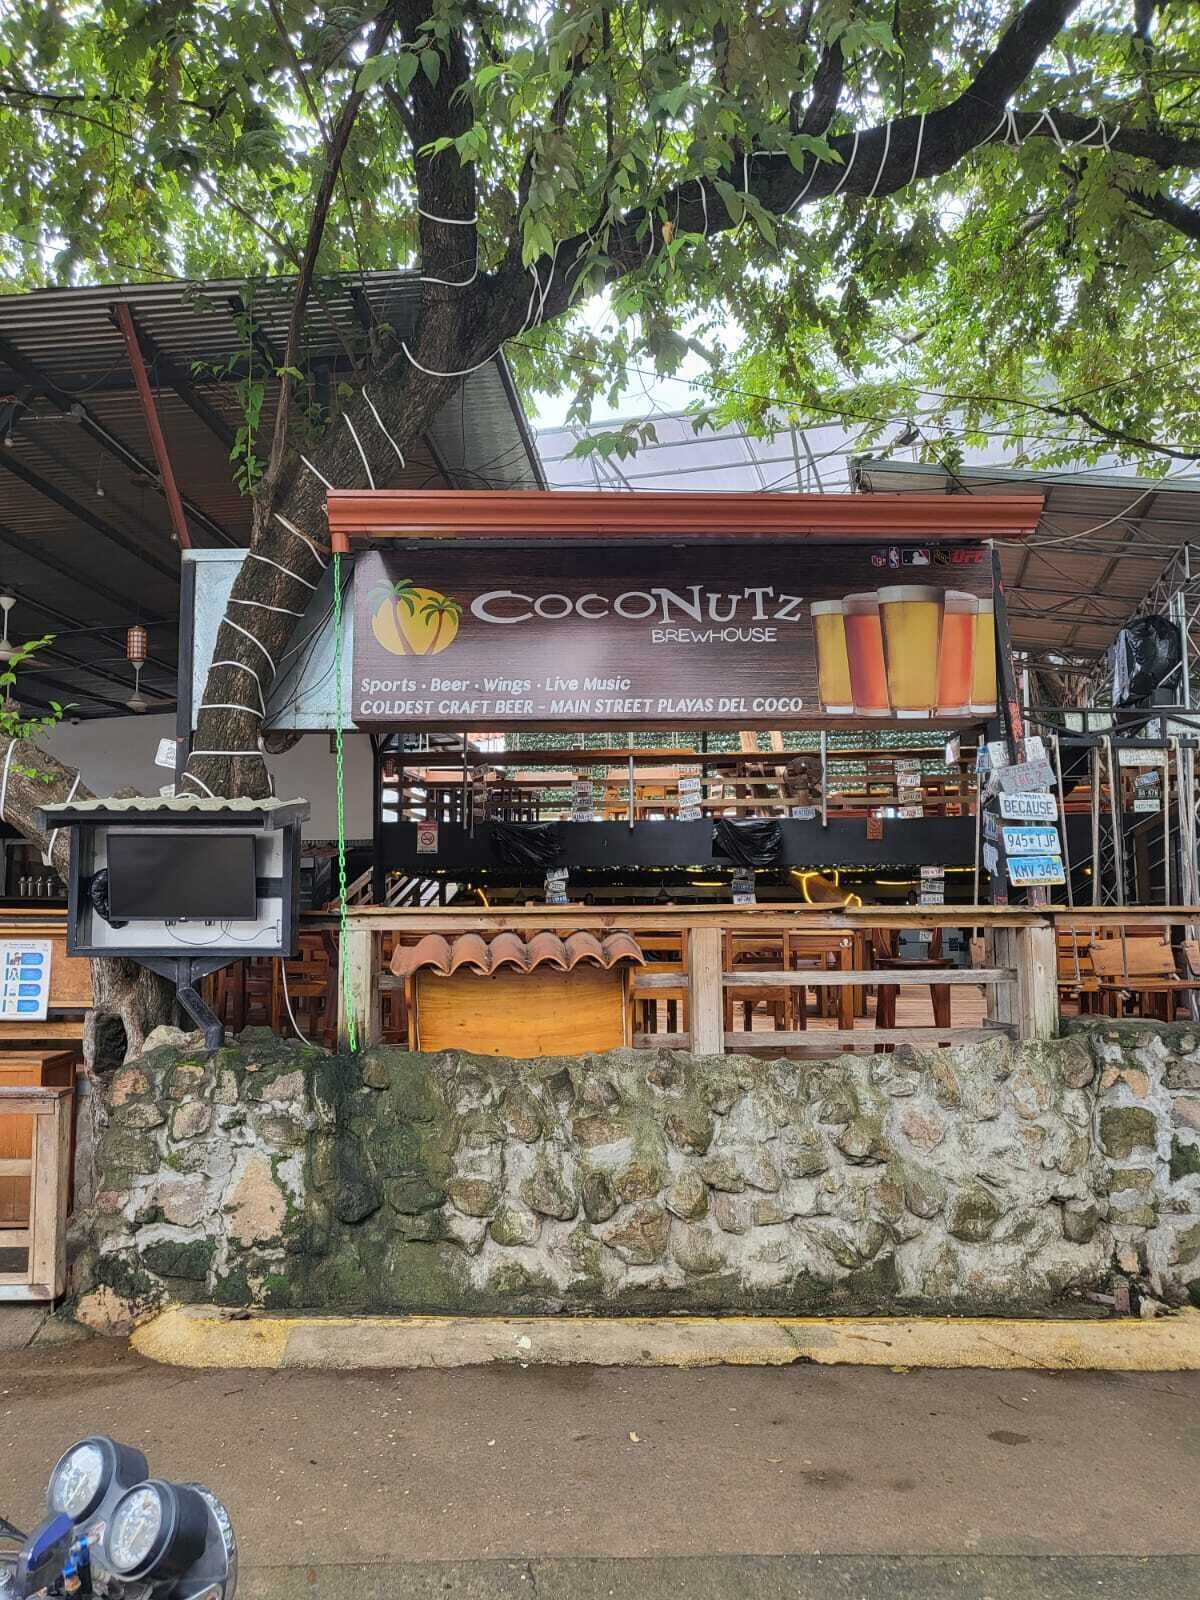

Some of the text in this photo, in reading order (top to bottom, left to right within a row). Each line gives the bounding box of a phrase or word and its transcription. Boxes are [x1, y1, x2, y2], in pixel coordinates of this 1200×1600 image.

[651, 628, 777, 644] BREWHOUSE
[360, 676, 631, 694] Sports Beer Wings Live Music
[360, 700, 434, 714] COLDEST
[438, 700, 492, 714] CRAFT
[494, 699, 534, 714] BEER
[549, 699, 590, 714] MAIN
[595, 698, 653, 713] STREET
[657, 698, 714, 713] PLAYAS
[718, 698, 748, 712] DEL
[752, 697, 803, 712] COCO
[1003, 799, 1054, 815] BECAUSE
[1013, 863, 1059, 878] KMV 345
